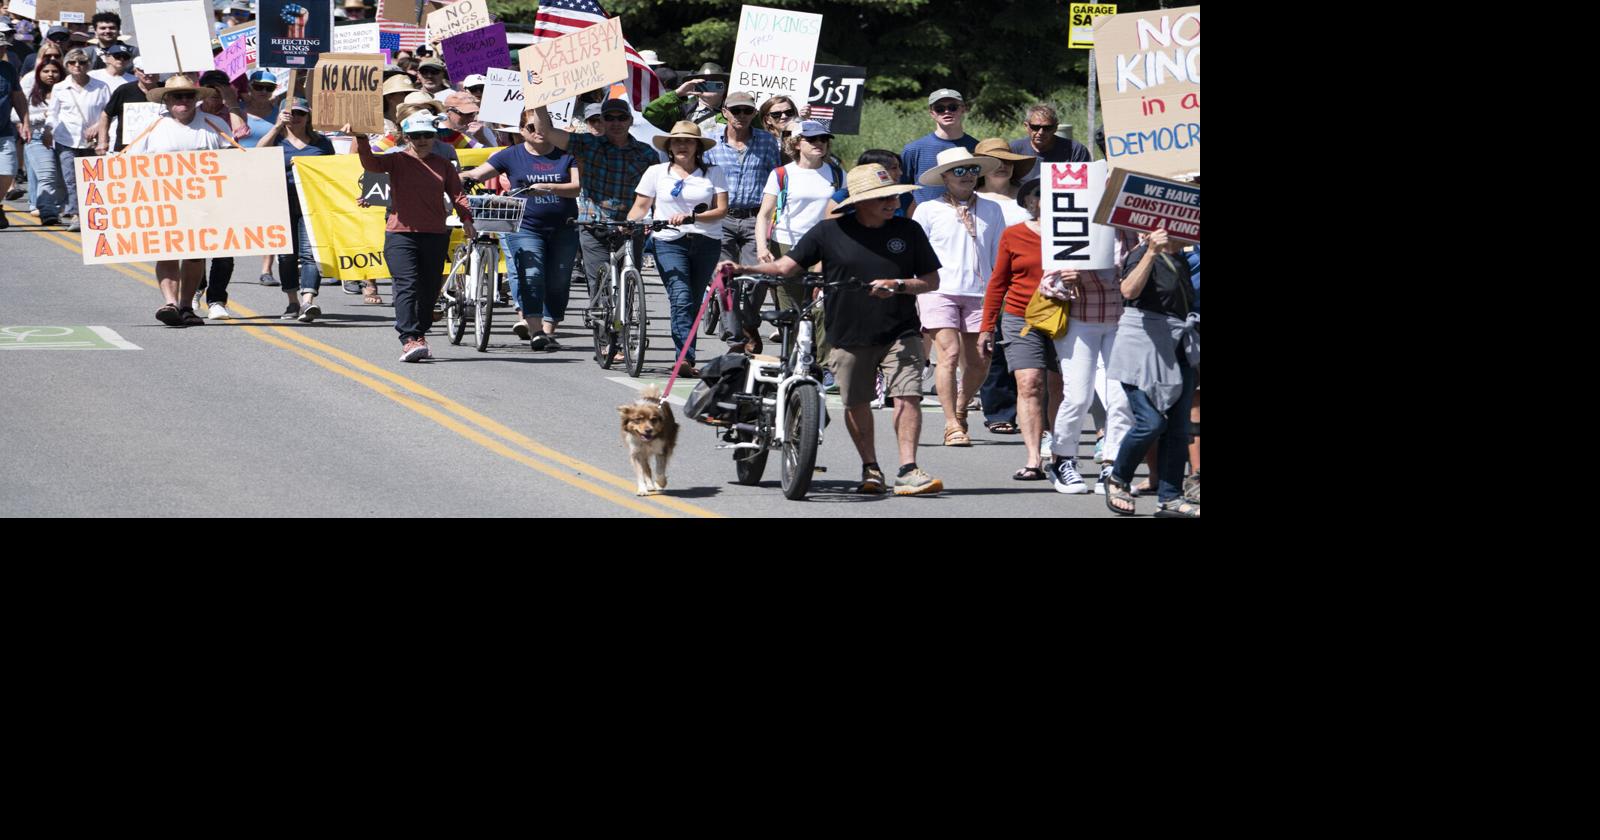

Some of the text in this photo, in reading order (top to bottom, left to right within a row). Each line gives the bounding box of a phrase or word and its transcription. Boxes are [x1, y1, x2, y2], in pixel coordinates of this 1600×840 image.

[445, 1, 472, 21] NO
[1073, 5, 1115, 14] GARAGE
[745, 12, 819, 35] NO KINGS
[1137, 12, 1200, 50] NO
[271, 38, 321, 46] REJECTING
[535, 19, 618, 58] VETERAN
[546, 60, 600, 88] TRUMP
[737, 51, 811, 74] CAUTION
[321, 64, 339, 91] NO
[341, 65, 380, 92] KING
[740, 72, 798, 92] BEWARE
[1141, 96, 1166, 117] in
[82, 152, 220, 182] MORONS
[526, 173, 562, 183] WHITE
[85, 175, 228, 206] AGAINST
[534, 194, 561, 204] BLUE
[1143, 183, 1200, 205] WE HAVE
[88, 204, 178, 231] GOOD
[1128, 212, 1199, 236] NOT A KING
[94, 225, 287, 257] AMERICANS
